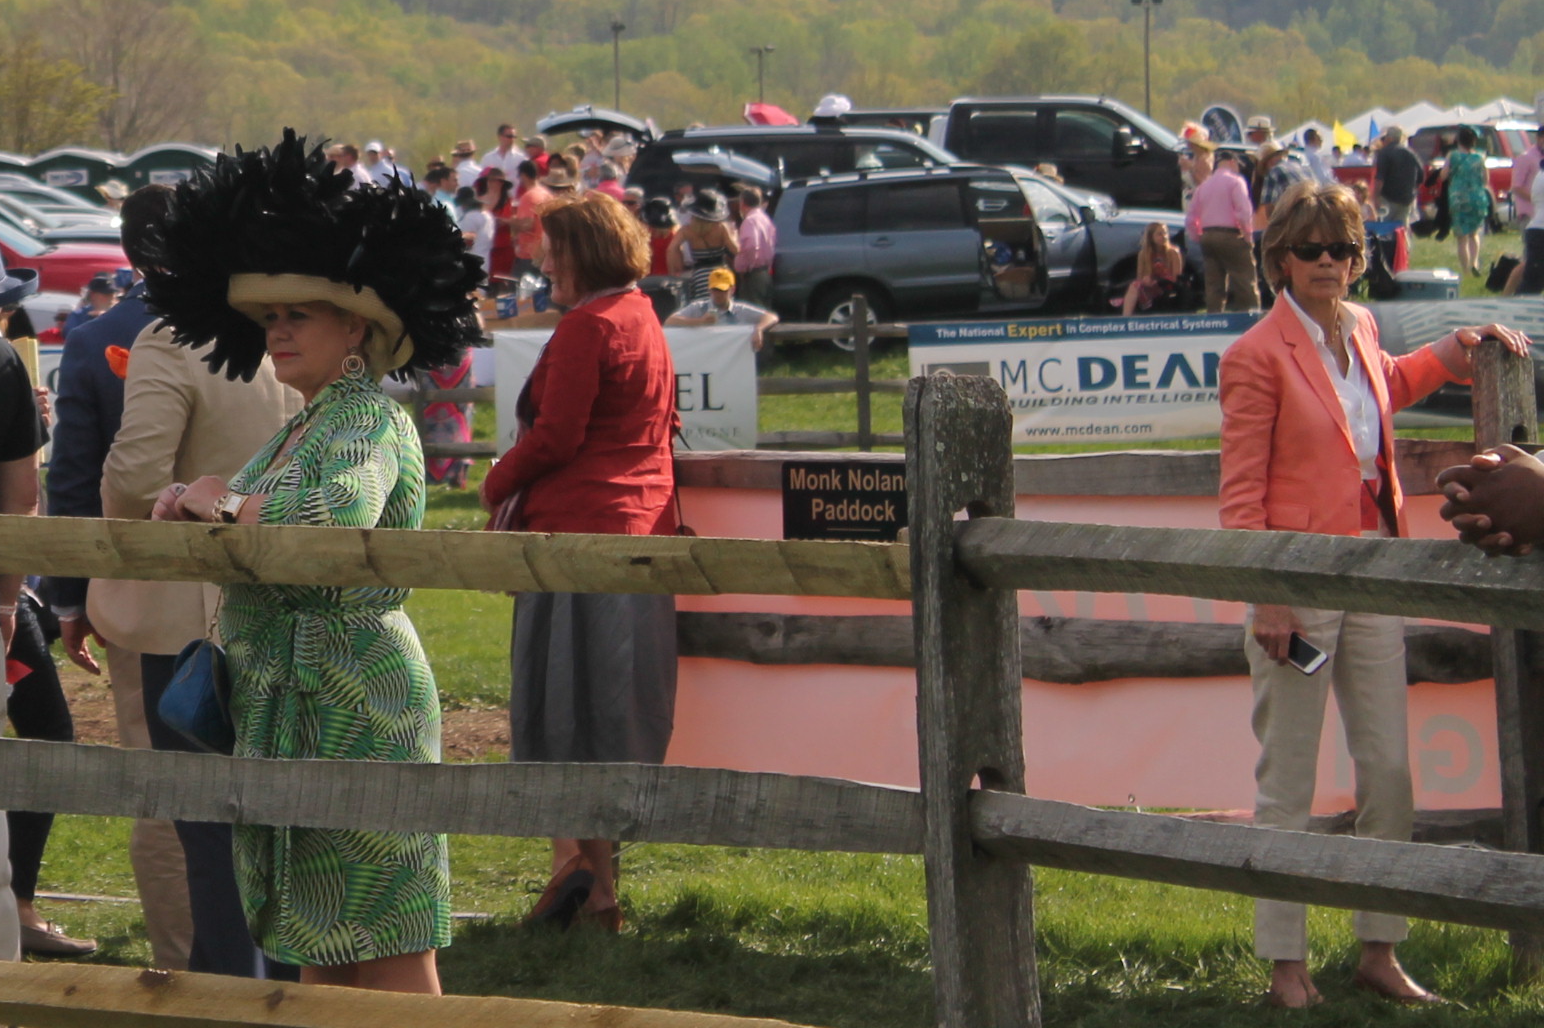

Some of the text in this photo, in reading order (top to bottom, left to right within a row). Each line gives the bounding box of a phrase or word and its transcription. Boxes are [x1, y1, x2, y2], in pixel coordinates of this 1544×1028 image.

[936, 328, 956, 338] The
[959, 326, 1004, 338] National
[1007, 324, 1063, 340] Expert
[1079, 323, 1126, 335] Complex
[1128, 320, 1179, 332] Electrical
[1182, 319, 1229, 331] Systems
[1025, 423, 1153, 437] www.mcdean.com
[789, 468, 842, 490] Monk
[812, 498, 896, 521] Paddock
